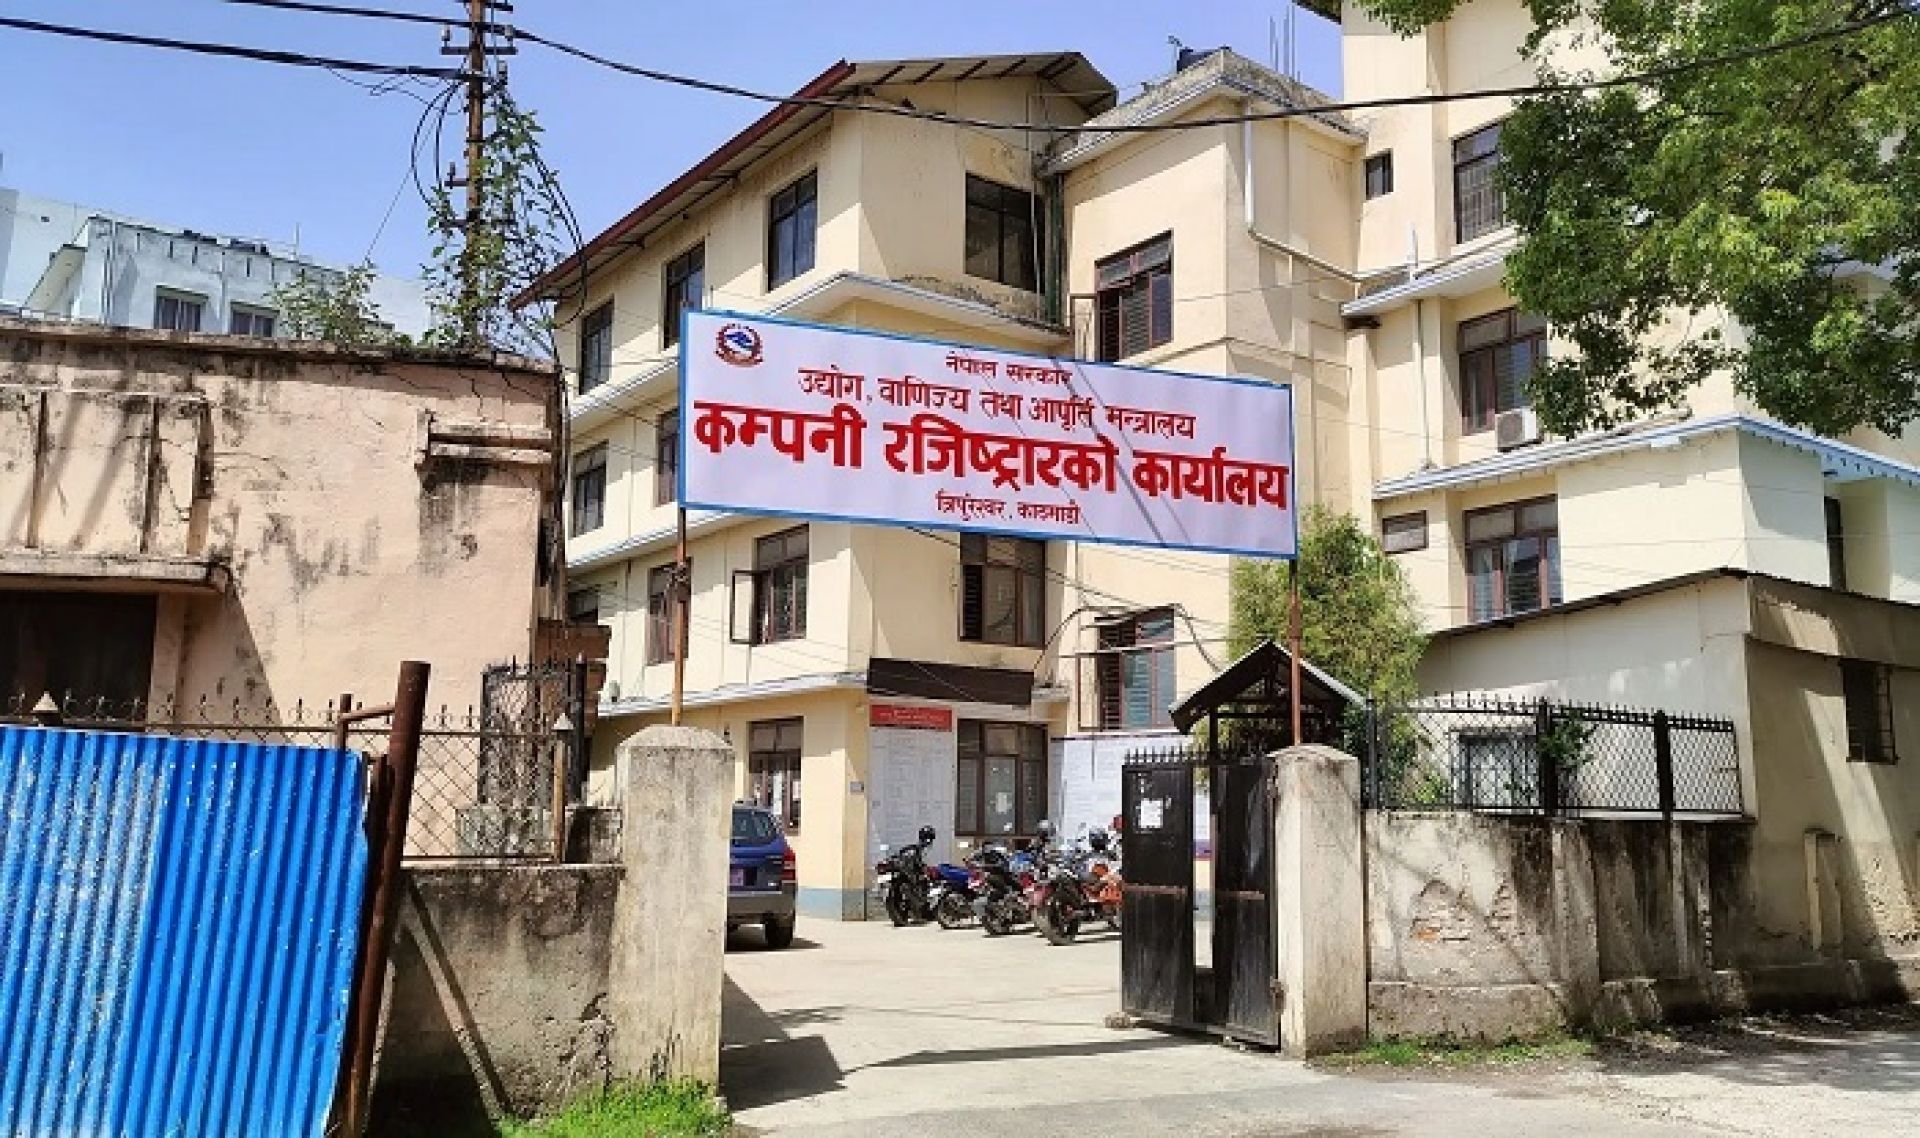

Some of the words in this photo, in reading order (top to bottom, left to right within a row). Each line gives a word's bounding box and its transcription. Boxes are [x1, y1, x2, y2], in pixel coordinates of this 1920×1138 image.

[946, 350, 998, 377] नेपाल
[1006, 363, 1073, 386] सरकार
[877, 375, 972, 412] वाणिज्य
[979, 391, 1023, 420] तथा
[1028, 394, 1097, 431] आपूर्ति
[1102, 404, 1197, 440] मन्त्रालय
[694, 400, 867, 469] कम्पनी
[883, 411, 1119, 494] रजिष्ट्रारको
[1132, 445, 1289, 510] कार्यालय
